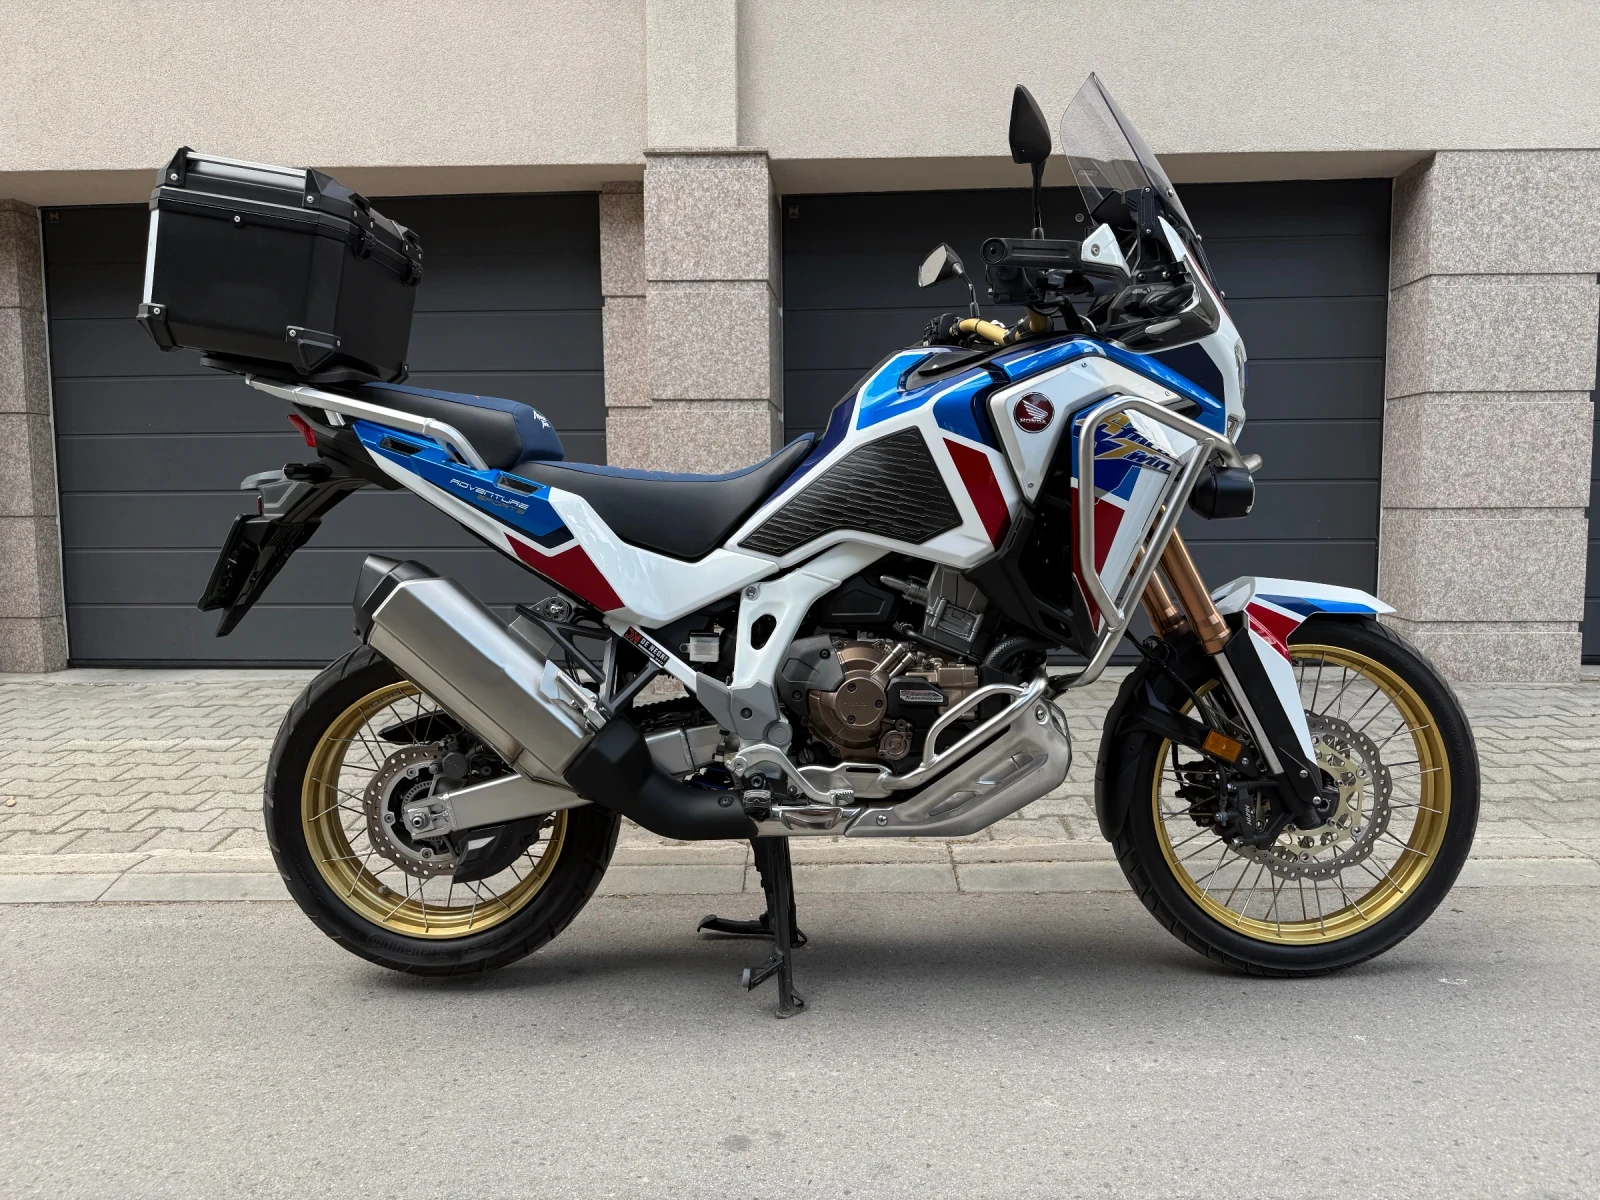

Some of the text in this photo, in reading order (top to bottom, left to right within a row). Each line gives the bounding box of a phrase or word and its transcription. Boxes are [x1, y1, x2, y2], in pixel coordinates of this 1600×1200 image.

[1094, 438, 1173, 471] Twin
[450, 478, 530, 510] ADVENTURE
[476, 494, 527, 515] SPORTS
[640, 638, 649, 648] DE
[648, 645, 669, 662] NEGRI
